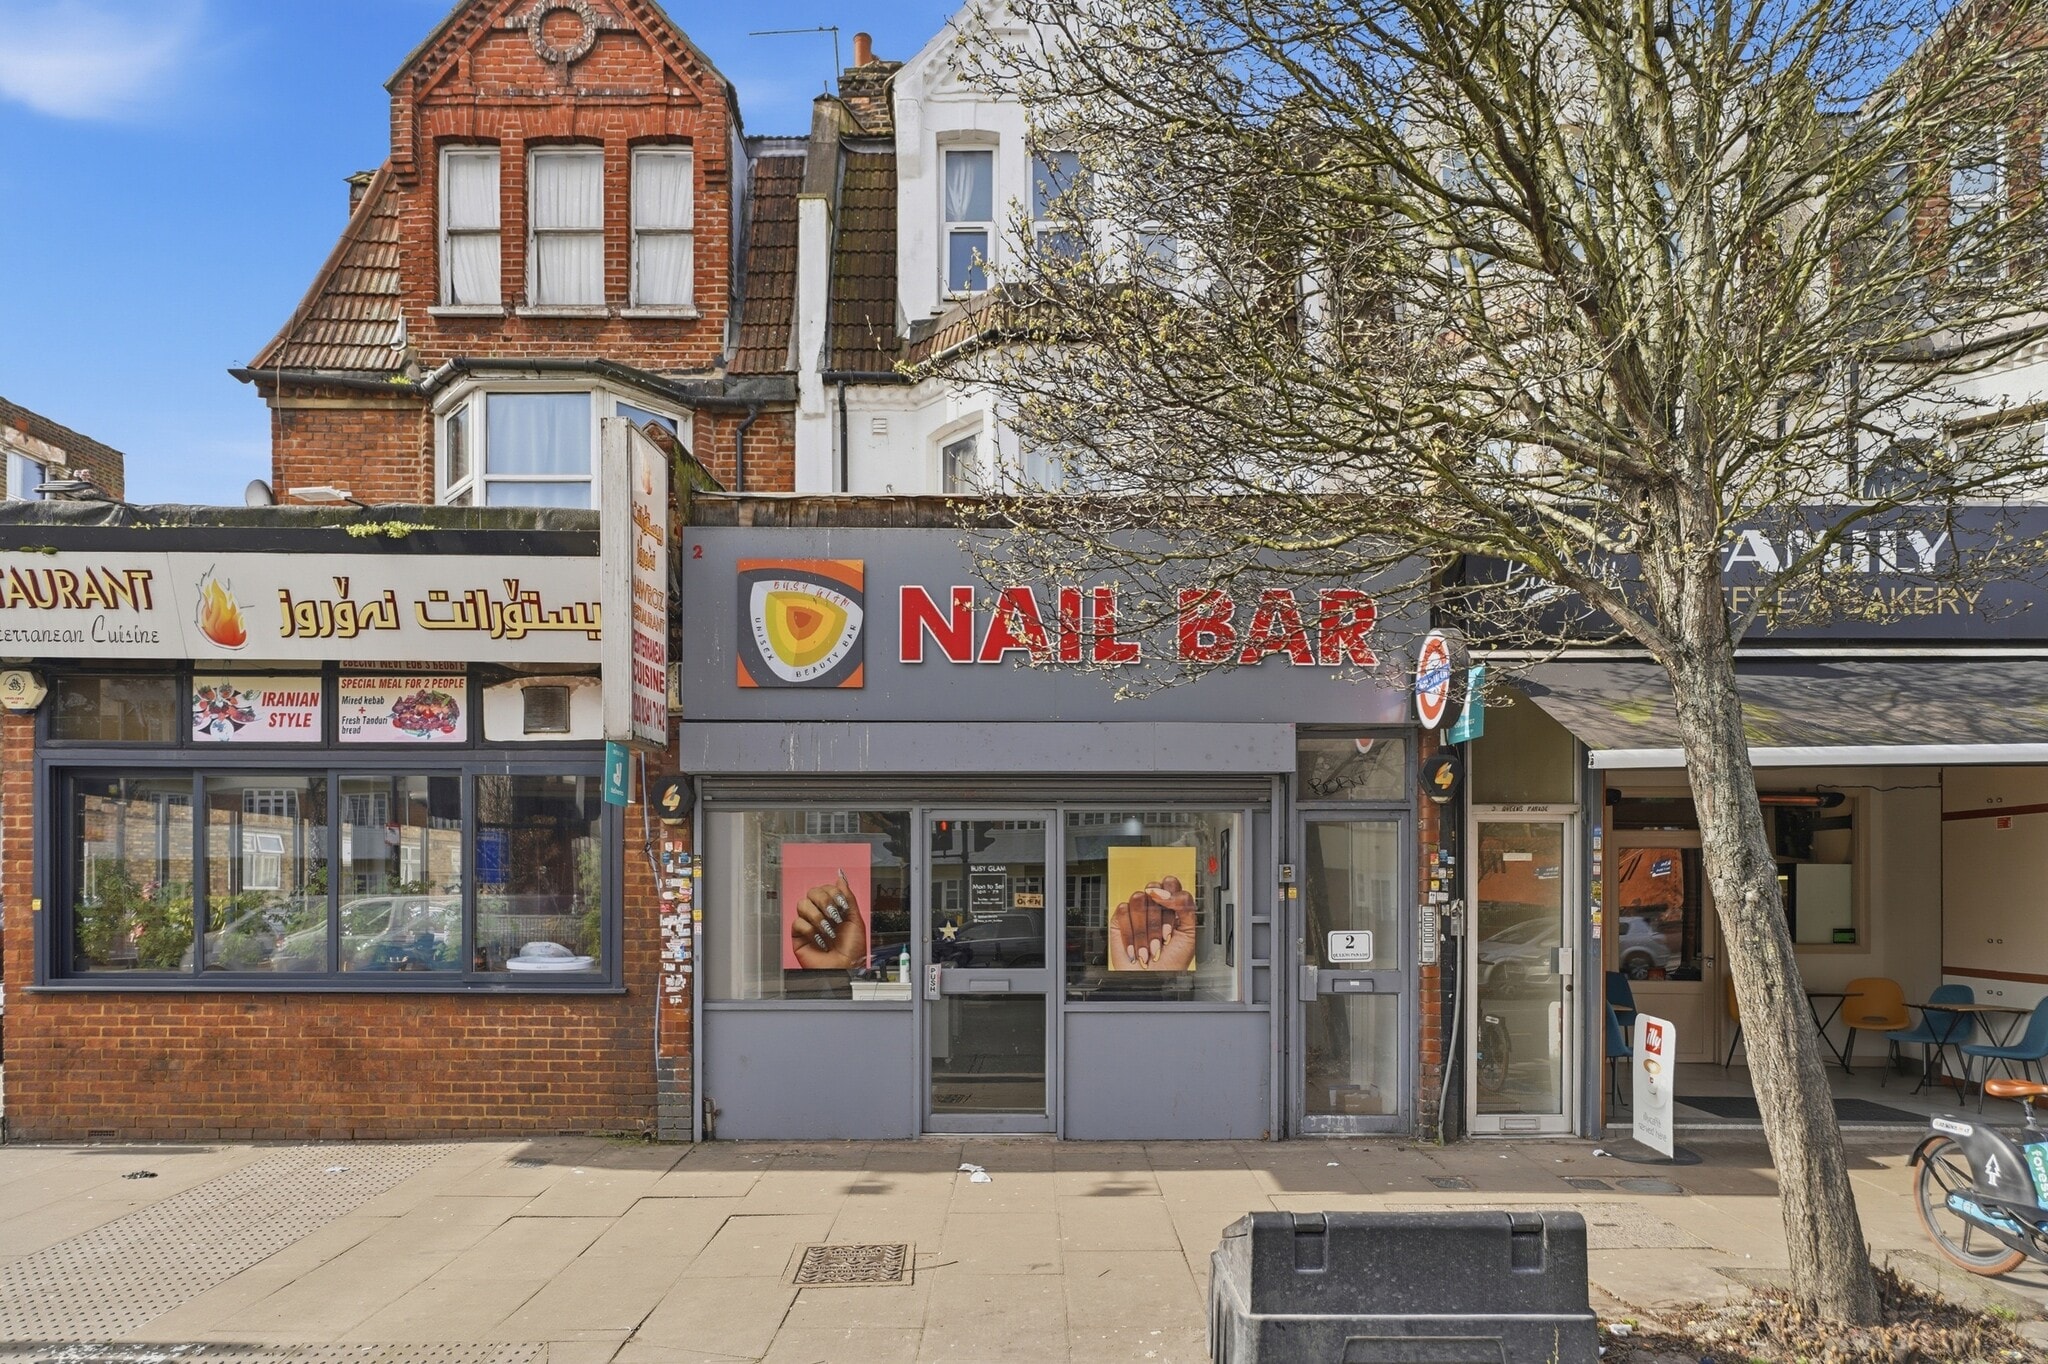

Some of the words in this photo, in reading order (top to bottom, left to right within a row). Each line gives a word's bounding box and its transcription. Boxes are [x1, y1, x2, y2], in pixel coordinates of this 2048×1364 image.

[693, 545, 702, 559] 2
[1721, 586, 1797, 614] FEE
[91, 615, 160, 643] Cuisine
[899, 585, 1141, 664] NAIL
[1177, 587, 1380, 666] BAR
[755, 617, 774, 661] UNISEX
[842, 624, 857, 647] BAR
[796, 652, 839, 678] BEAUTY
[341, 679, 376, 688] SPECIAL
[379, 679, 402, 688] MEAL
[405, 679, 422, 688] FOR
[424, 679, 430, 688] 2
[432, 679, 464, 688] PEOPLE
[633, 658, 665, 694] CUISINE
[262, 692, 319, 707] IRANIAN
[342, 696, 362, 704] Mixed
[363, 696, 385, 704] kebab
[269, 713, 312, 727] STYLE
[342, 716, 360, 724] Fresh
[342, 726, 361, 734] bread
[1345, 935, 1354, 949] 2
[1647, 1027, 1661, 1051] illy
